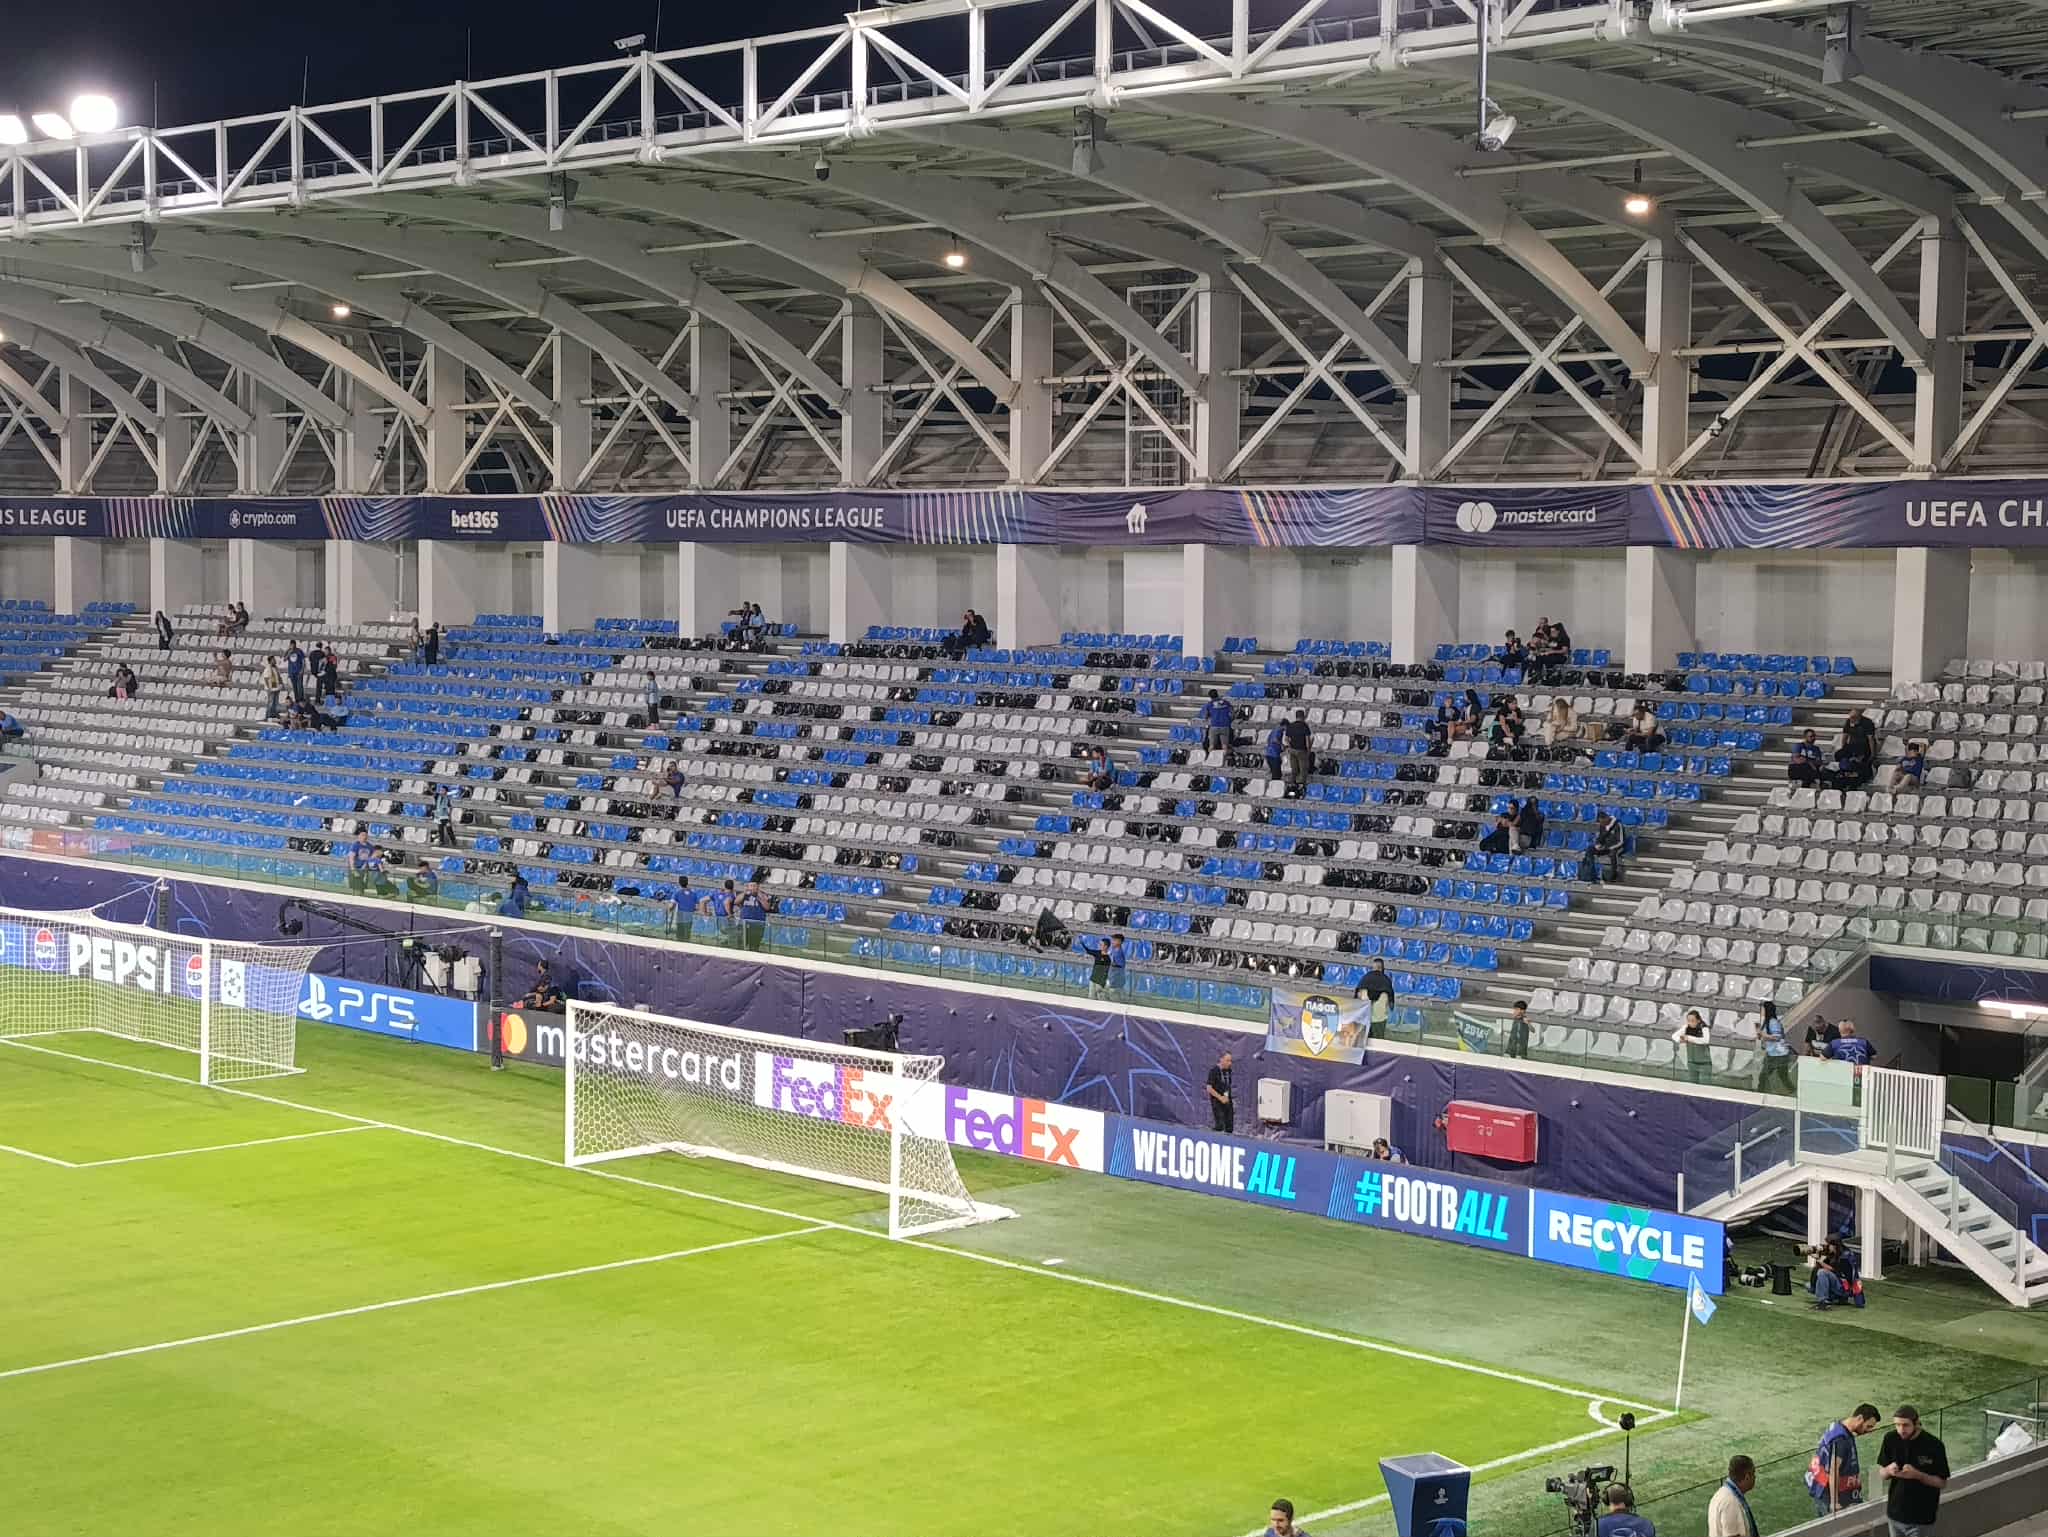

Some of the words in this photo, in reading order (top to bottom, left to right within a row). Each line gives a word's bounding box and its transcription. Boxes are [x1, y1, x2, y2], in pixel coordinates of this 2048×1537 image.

[19, 509, 87, 526] LEAGUE
[243, 512, 296, 527] crypto.com
[451, 509, 498, 528] bet365
[666, 509, 706, 528] UEFA
[710, 508, 810, 529] CHAMPIONS
[814, 507, 884, 528] LEAGUE
[1502, 505, 1597, 523] mastercard
[1906, 501, 1988, 527] UEFA
[1998, 500, 2048, 527] CH
[69, 932, 172, 994] PEPSI
[338, 986, 415, 1030] PS5
[536, 1024, 741, 1091] mastercard
[773, 1056, 893, 1131] FedEx
[945, 1084, 1080, 1167] FedEx
[1133, 1128, 1245, 1190] WELCOME
[1247, 1151, 1297, 1199] ALL
[1354, 1171, 1509, 1241] #FOOTBALL
[1549, 1209, 1705, 1269] RECYCLE
